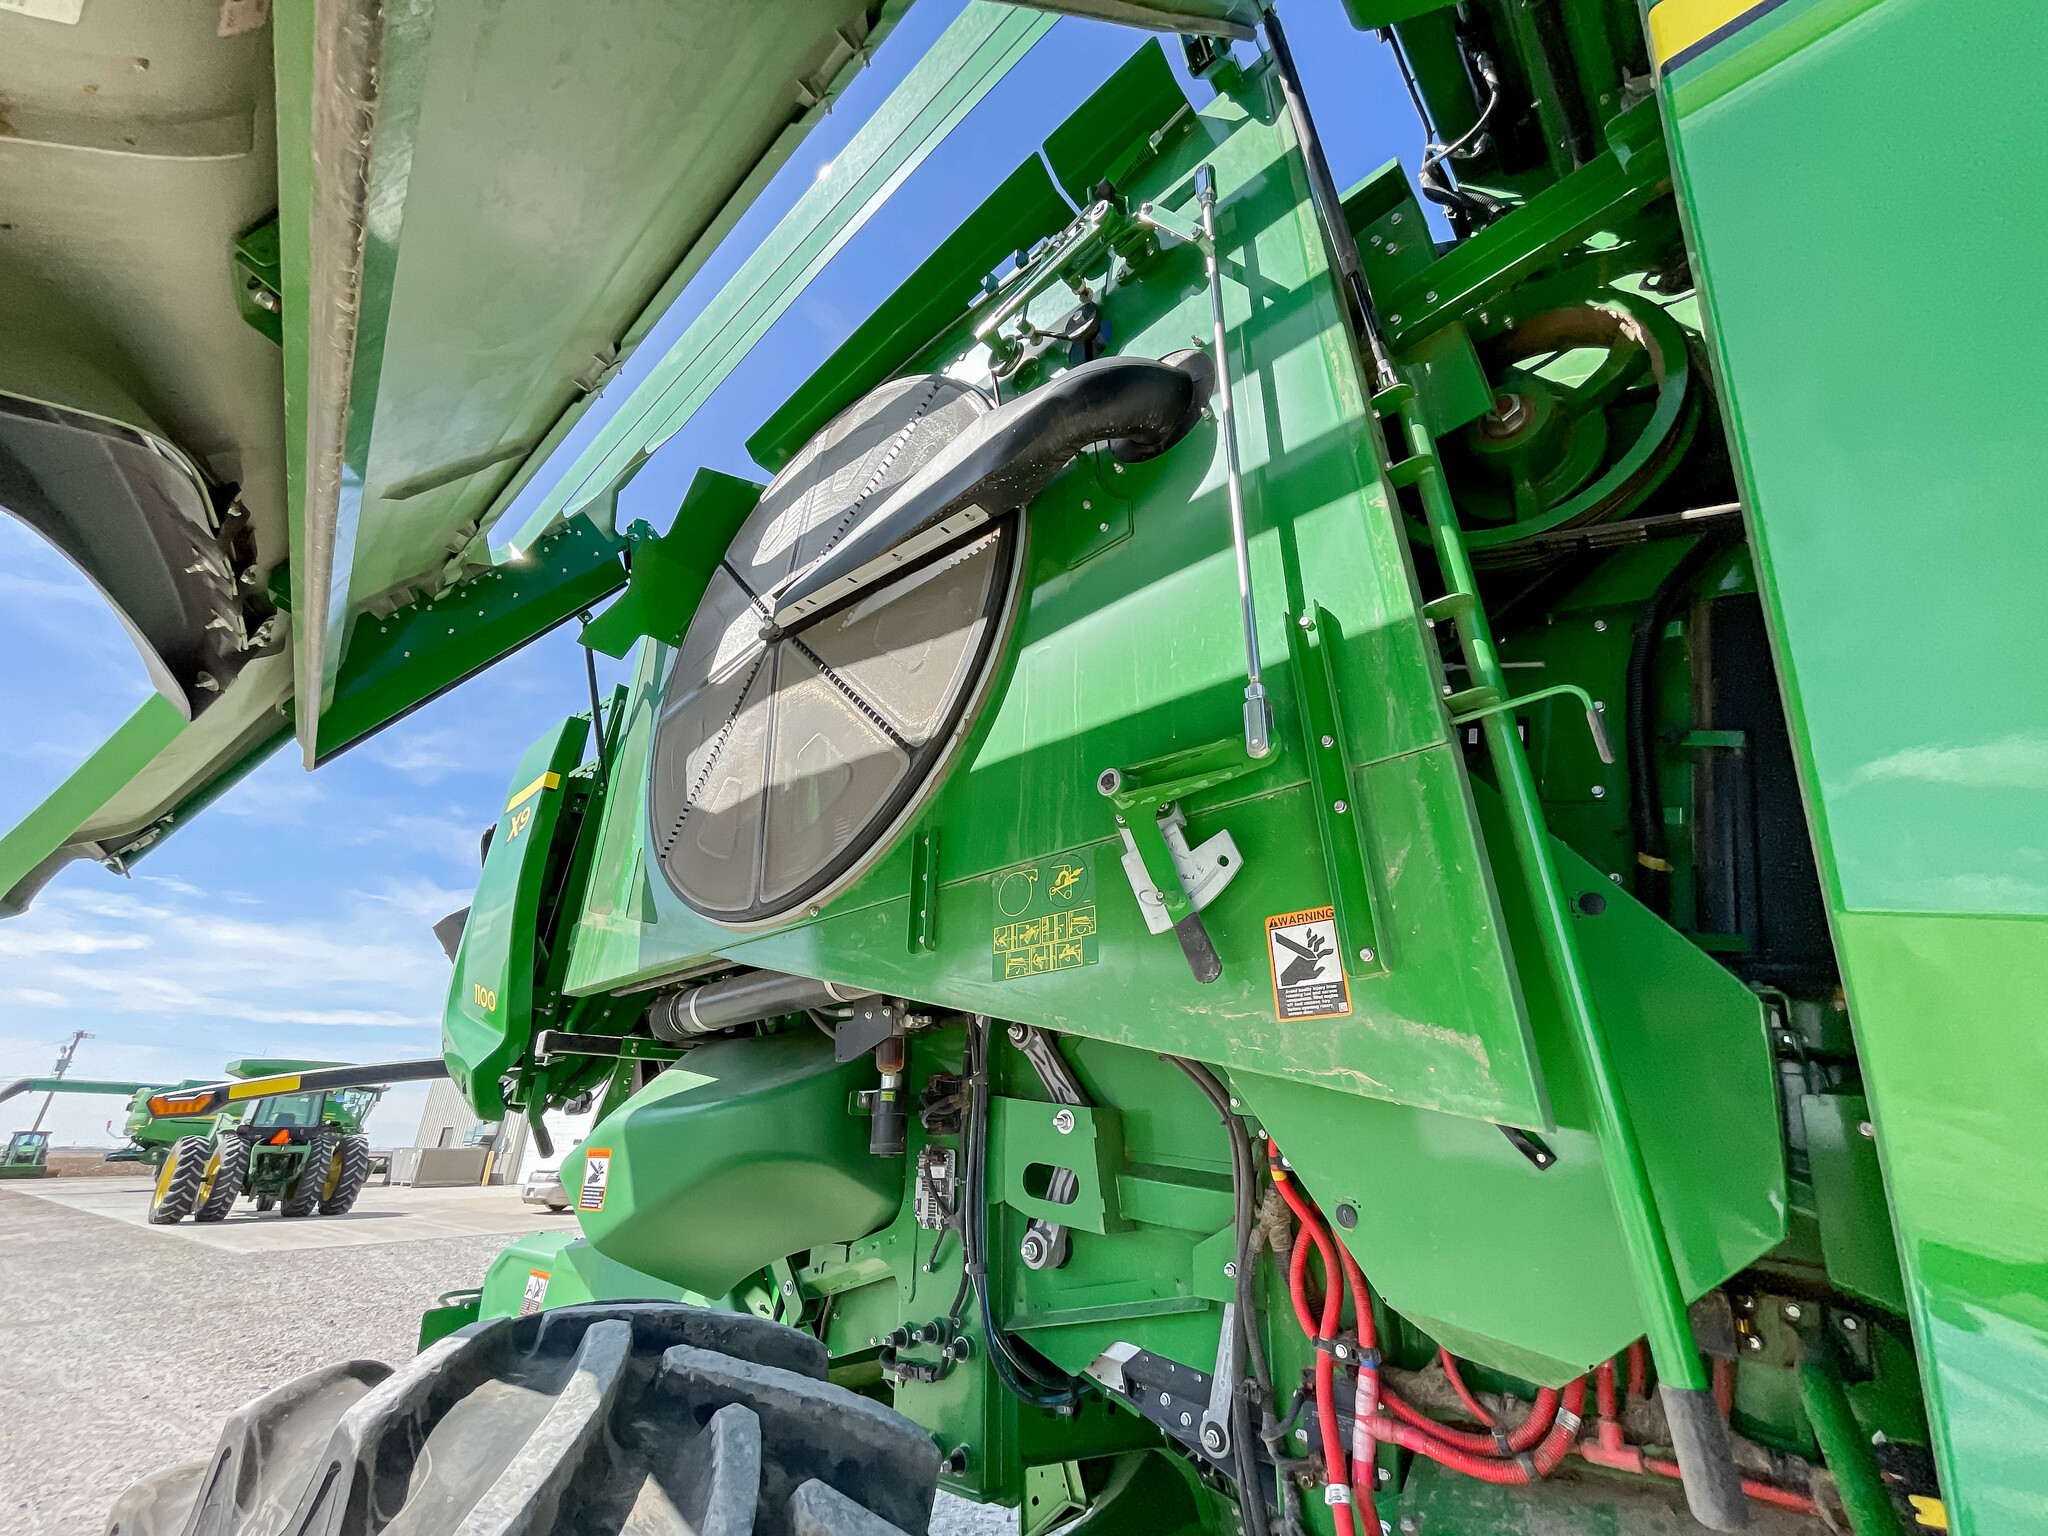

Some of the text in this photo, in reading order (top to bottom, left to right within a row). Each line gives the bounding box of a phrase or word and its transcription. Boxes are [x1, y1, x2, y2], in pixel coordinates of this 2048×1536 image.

[505, 805, 531, 844] X9
[1277, 908, 1335, 926] WARNING
[474, 983, 496, 1012] 1100
